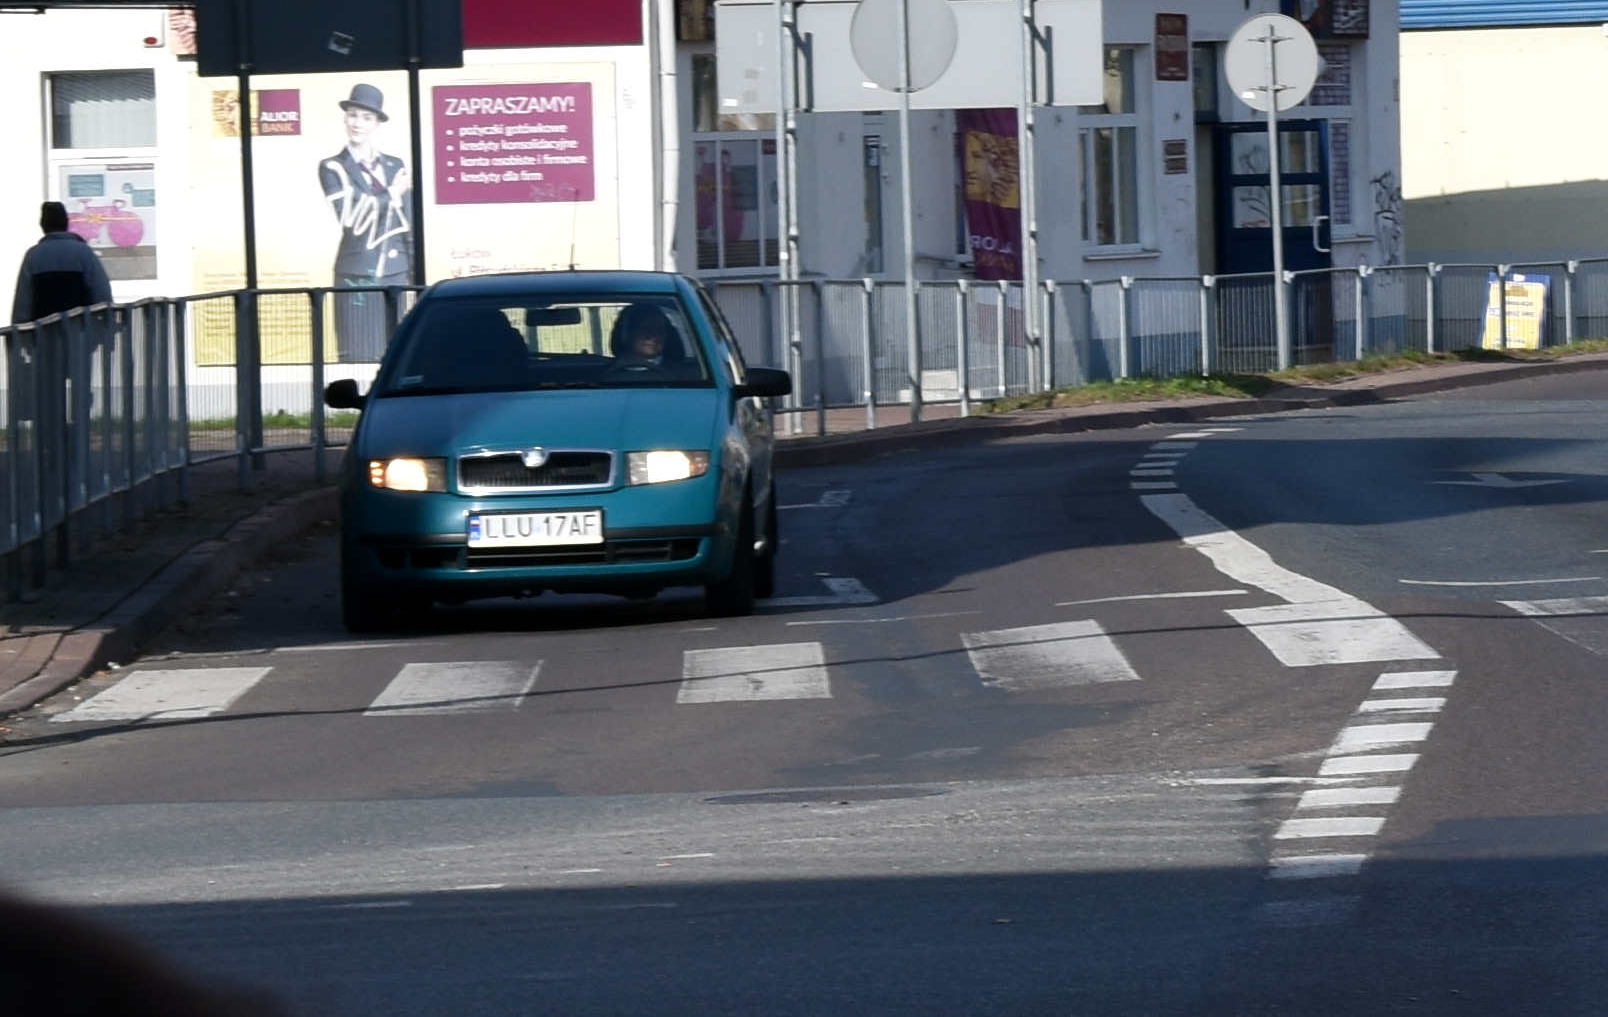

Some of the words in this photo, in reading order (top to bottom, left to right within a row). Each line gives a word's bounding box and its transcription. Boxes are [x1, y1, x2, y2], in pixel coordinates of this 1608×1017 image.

[445, 96, 576, 115] ZAPRASZAMY!
[485, 516, 533, 539] LLU
[543, 514, 597, 537] 17AF
